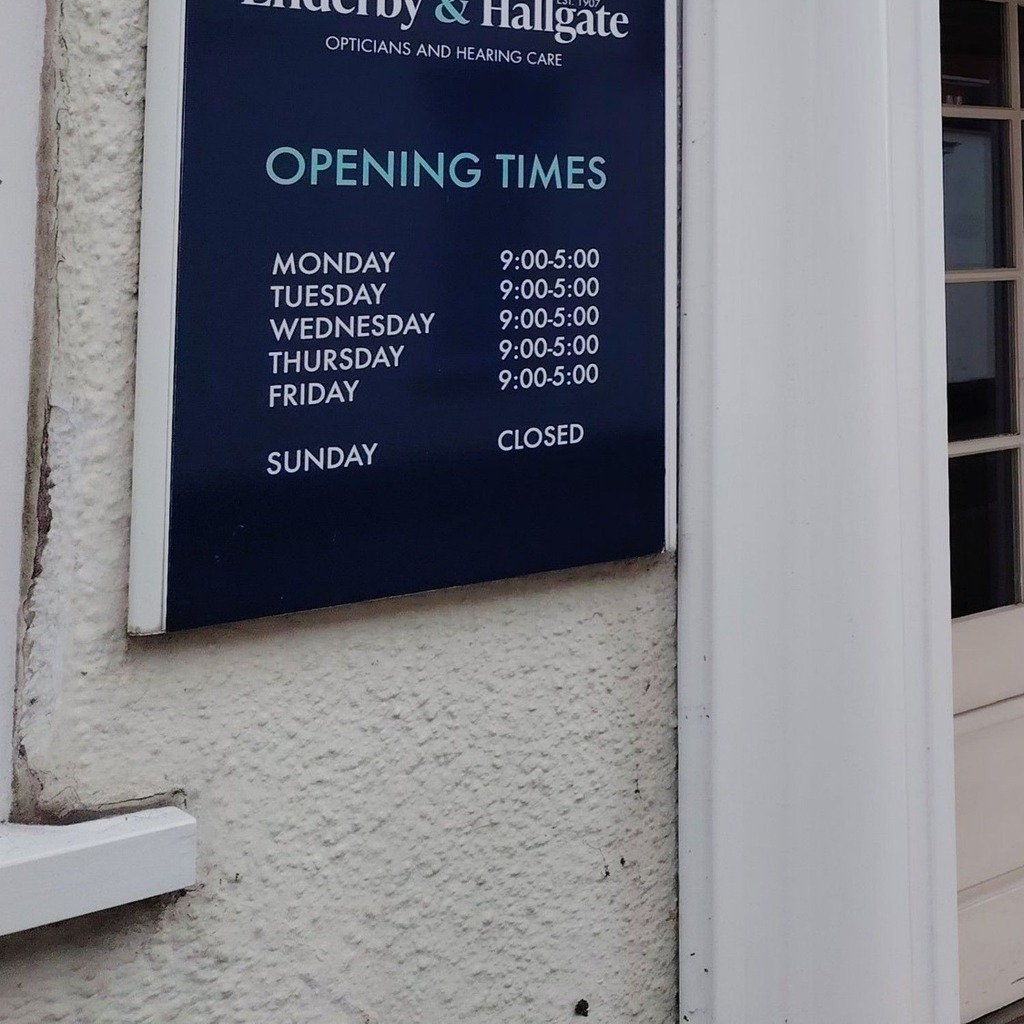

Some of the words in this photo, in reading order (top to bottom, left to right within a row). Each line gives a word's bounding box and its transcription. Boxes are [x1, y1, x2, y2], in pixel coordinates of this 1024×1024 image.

[325, 35, 411, 56] OPTICIANS
[416, 43, 451, 59] AND
[457, 46, 522, 64] HEARING
[527, 50, 563, 67] CARE
[266, 146, 481, 188] OPENING
[496, 153, 607, 190] TIMES
[272, 251, 395, 275] MONDAY
[500, 248, 600, 270] 9:00-5:00
[270, 283, 386, 308] TUESDAY
[500, 276, 600, 300] 9:00-5:00
[269, 313, 435, 341] WEDNESDAY
[499, 305, 599, 330] 9:00-5:00
[269, 345, 404, 374] THURSDAY
[499, 334, 599, 360] 9:00-5:00
[498, 363, 599, 391] 9:00-5:00
[269, 380, 359, 407] FRIDAY
[497, 423, 584, 451] CLOSED
[267, 443, 378, 475] SUNDAY
